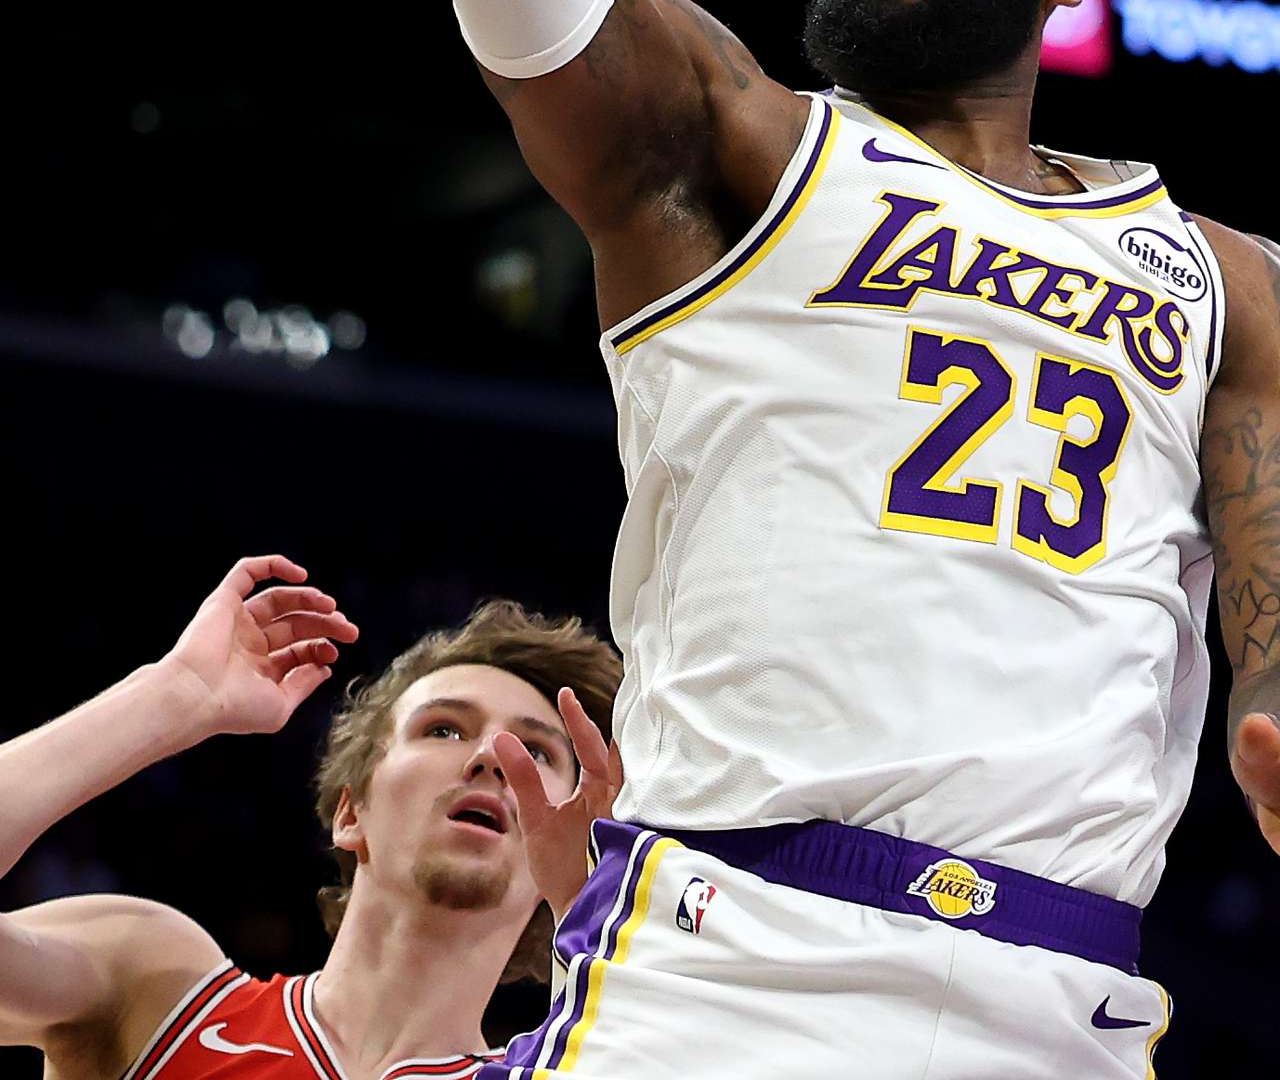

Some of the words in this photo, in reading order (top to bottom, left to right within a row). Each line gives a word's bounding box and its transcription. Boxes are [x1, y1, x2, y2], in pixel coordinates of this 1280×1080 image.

[805, 189, 1190, 396] LAKERS
[1127, 236, 1202, 290] bibigo
[878, 323, 1136, 575] 23
[909, 868, 991, 912] LAKERS
